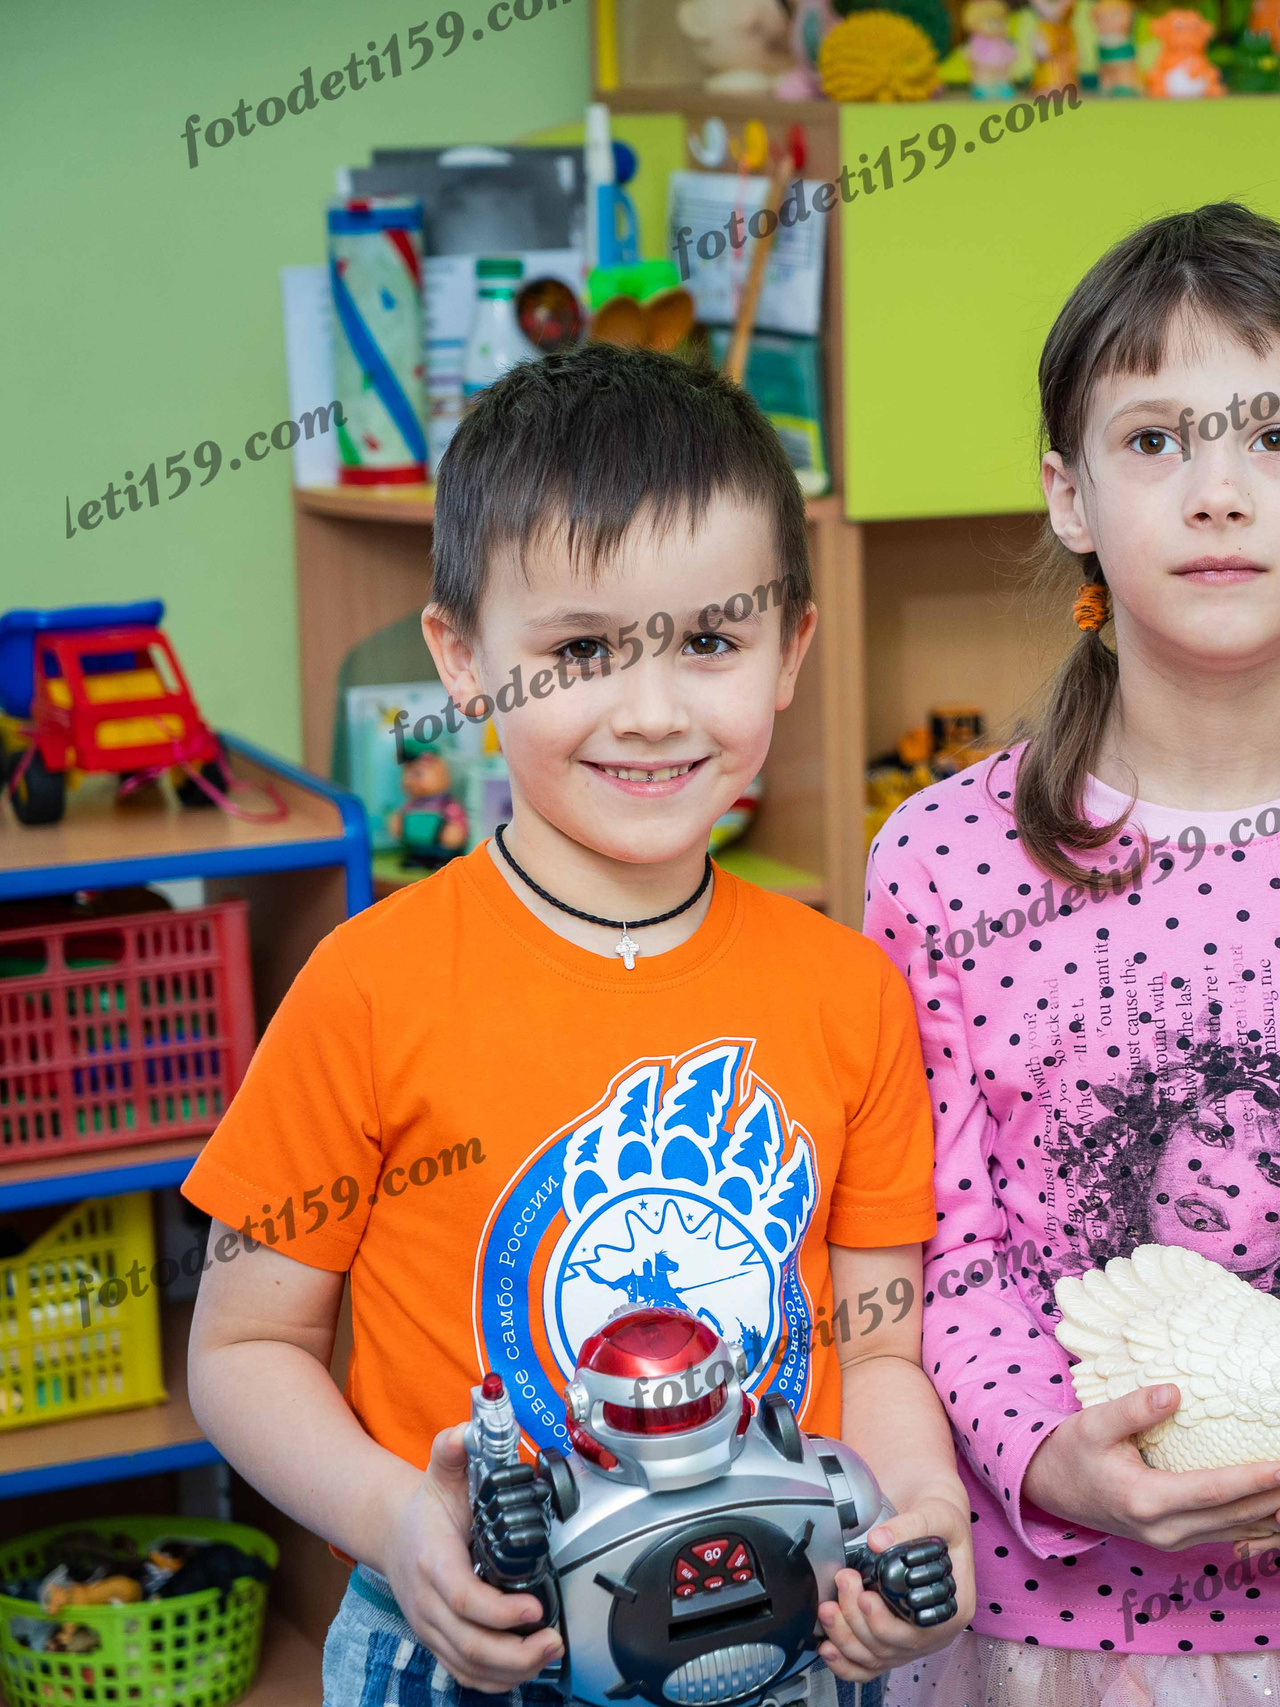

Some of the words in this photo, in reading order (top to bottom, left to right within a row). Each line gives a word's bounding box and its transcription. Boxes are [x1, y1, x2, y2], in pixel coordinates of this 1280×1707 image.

[1119, 958, 1138, 985] the
[1124, 989, 1141, 1036] cause
[1147, 975, 1166, 1014] with
[1200, 976, 1225, 1033] thy're
[1045, 1014, 1062, 1046] sick
[1176, 1011, 1194, 1038] the
[1259, 990, 1279, 1054] missing
[1025, 1057, 1046, 1089] with
[1126, 1040, 1145, 1072] just
[1038, 1104, 1054, 1152] spend
[1043, 1167, 1056, 1208] must
[498, 1175, 560, 1268] России
[497, 1276, 521, 1361] самбо
[778, 1299, 800, 1391] Сосново
[704, 1547, 721, 1562] GO
